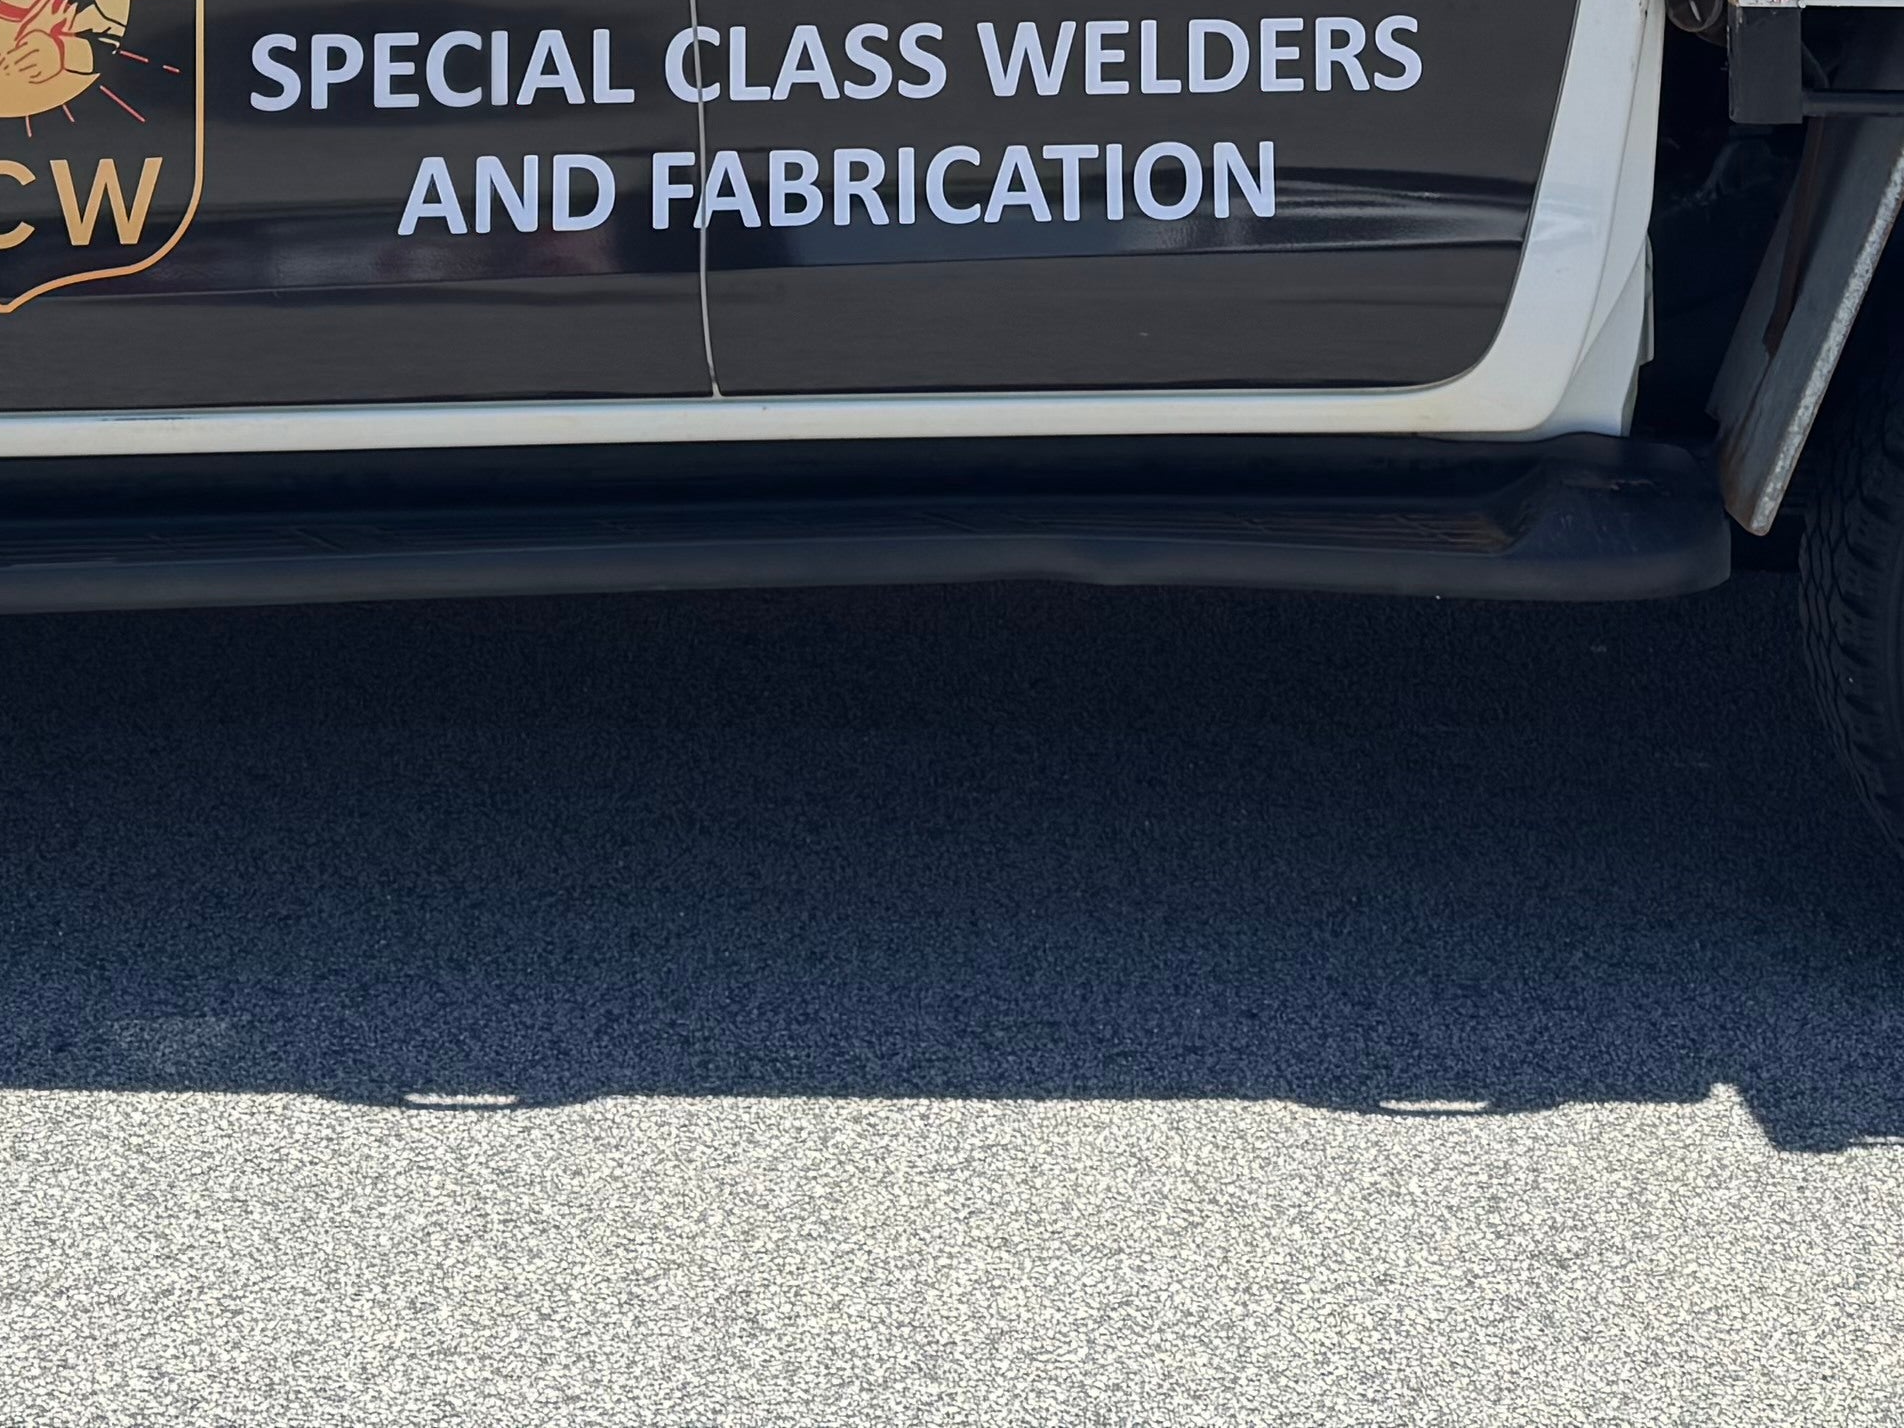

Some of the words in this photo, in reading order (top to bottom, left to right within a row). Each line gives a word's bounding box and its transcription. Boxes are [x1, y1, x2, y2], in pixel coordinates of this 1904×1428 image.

[249, 28, 635, 112] SPECIAL
[663, 22, 948, 104] CLASS
[976, 15, 1424, 97] WELDERS
[397, 153, 617, 236] AND
[652, 140, 1276, 230] FABRICATION
